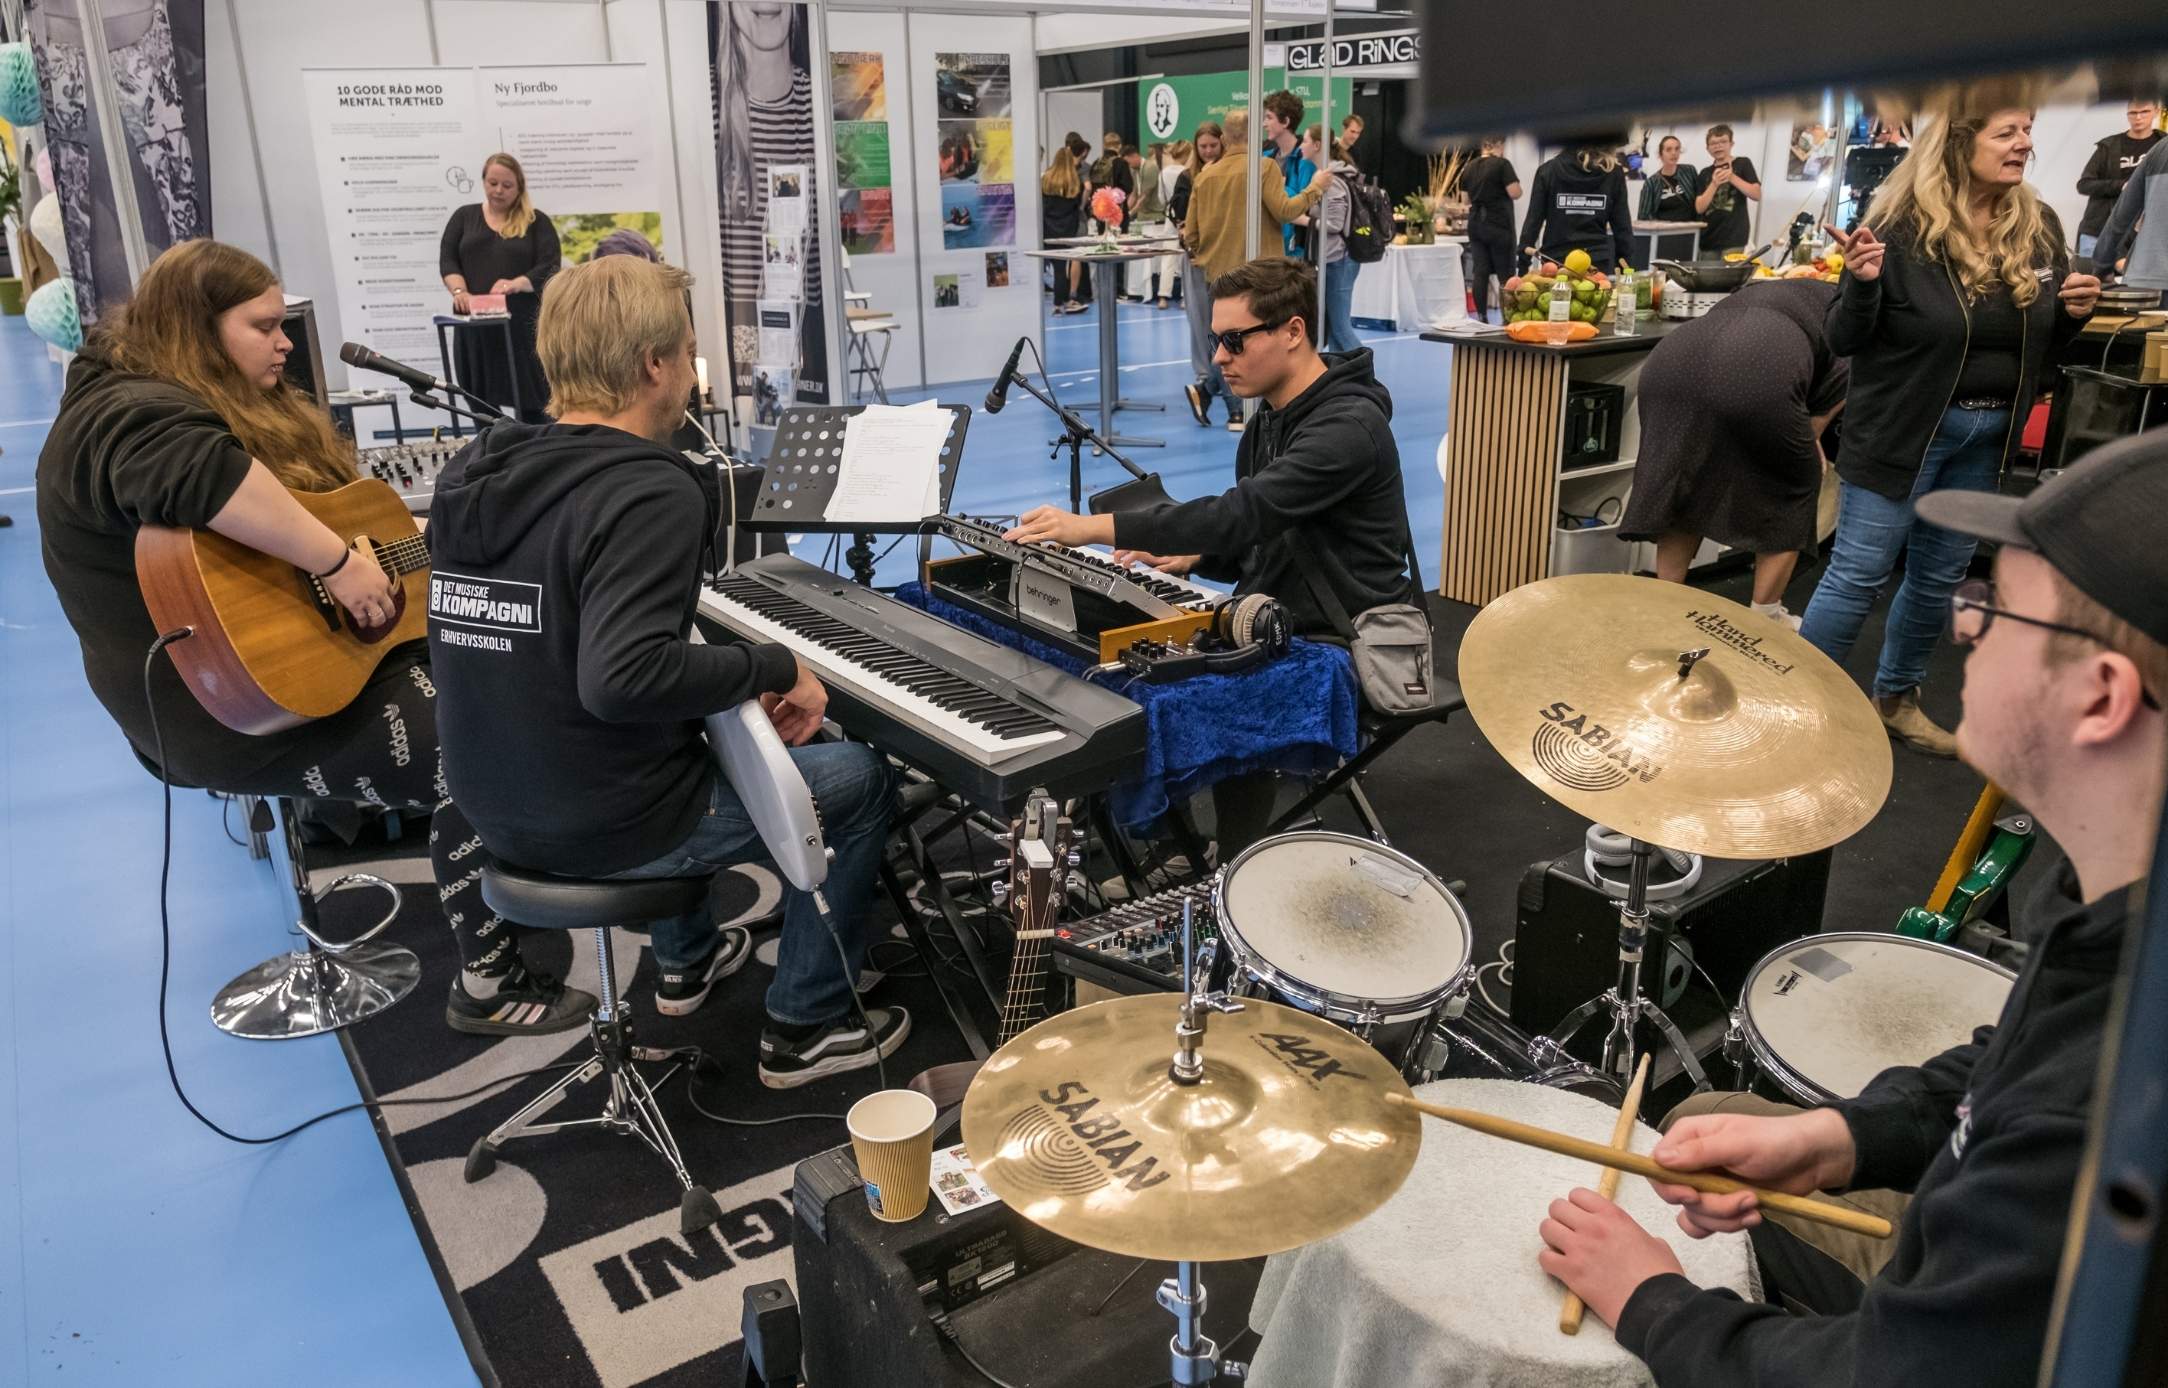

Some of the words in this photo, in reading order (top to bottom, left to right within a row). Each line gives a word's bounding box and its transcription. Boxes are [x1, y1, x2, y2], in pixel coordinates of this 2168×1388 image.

[337, 86, 351, 95] 10
[353, 85, 387, 95] GODE
[389, 83, 413, 95] RÅD
[415, 85, 443, 95] MOD
[340, 97, 386, 107] MENTAL
[387, 97, 444, 107] TRÆTHED
[494, 83, 510, 96] Ny
[513, 82, 558, 96] Fjordbo
[443, 581, 456, 595] DET
[456, 583, 490, 599] MUSISKE
[1026, 584, 1061, 606] behringer
[442, 594, 533, 625] KOMPAGNI
[440, 628, 513, 652] ERHVERVSSKOLEN
[1685, 610, 1795, 675] Hammered
[1707, 614, 1763, 646] Hand
[389, 718, 410, 767] adidas
[1539, 701, 1662, 784] SABIAN
[448, 835, 483, 861] adid
[1038, 1080, 1171, 1192] SABIAN
